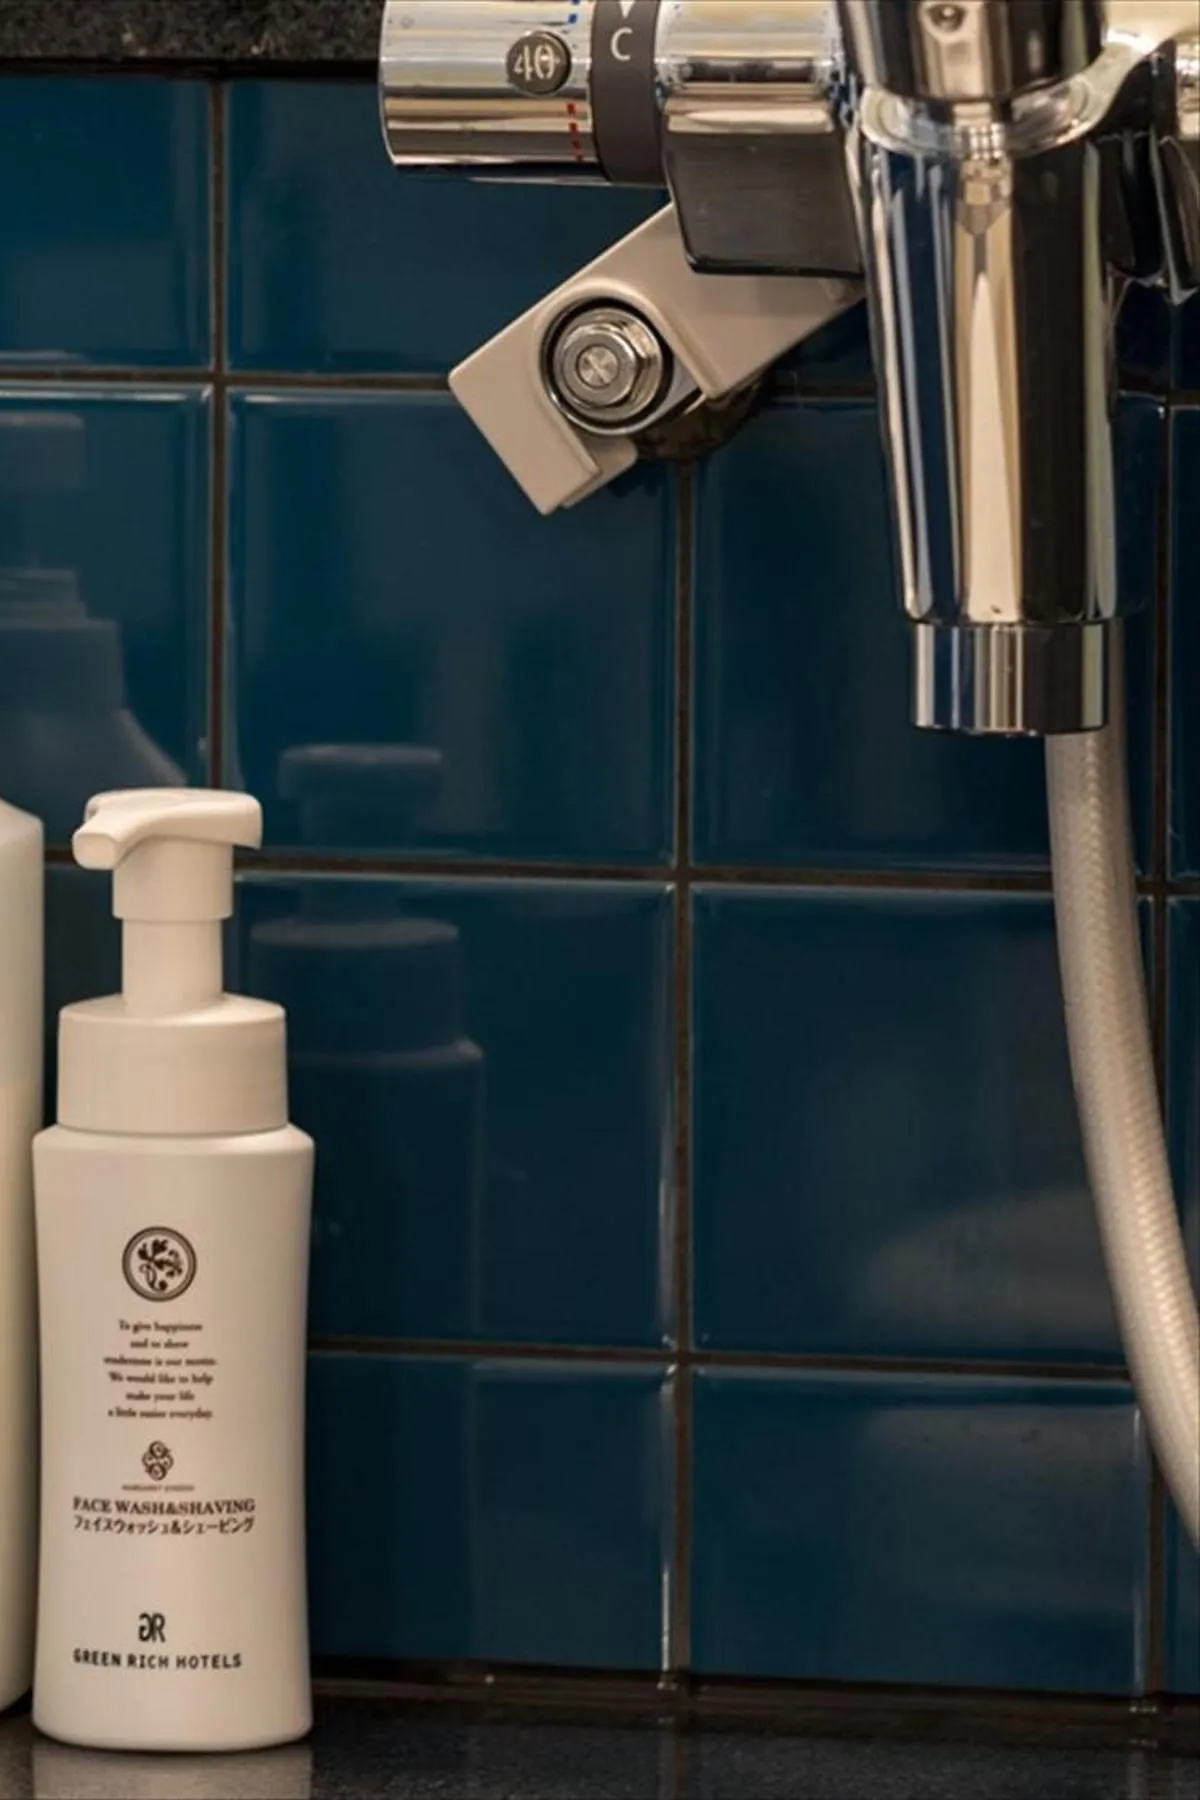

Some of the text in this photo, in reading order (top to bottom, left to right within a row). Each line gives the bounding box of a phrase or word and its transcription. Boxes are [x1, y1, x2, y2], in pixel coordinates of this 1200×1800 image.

[611, 28, 633, 61] C
[513, 44, 557, 81] 40
[118, 1320, 130, 1331] To
[133, 1322, 151, 1334] give
[130, 1340, 148, 1349] and
[109, 1372, 123, 1382] We
[127, 1373, 155, 1384] would
[158, 1374, 175, 1384] like
[192, 1374, 213, 1386] help
[126, 1392, 194, 1403] make your life
[116, 1407, 137, 1418] little
[73, 1497, 255, 1515] FACE WASH&SHAVING
[73, 1648, 242, 1669] GREEN RICH HOTELS
